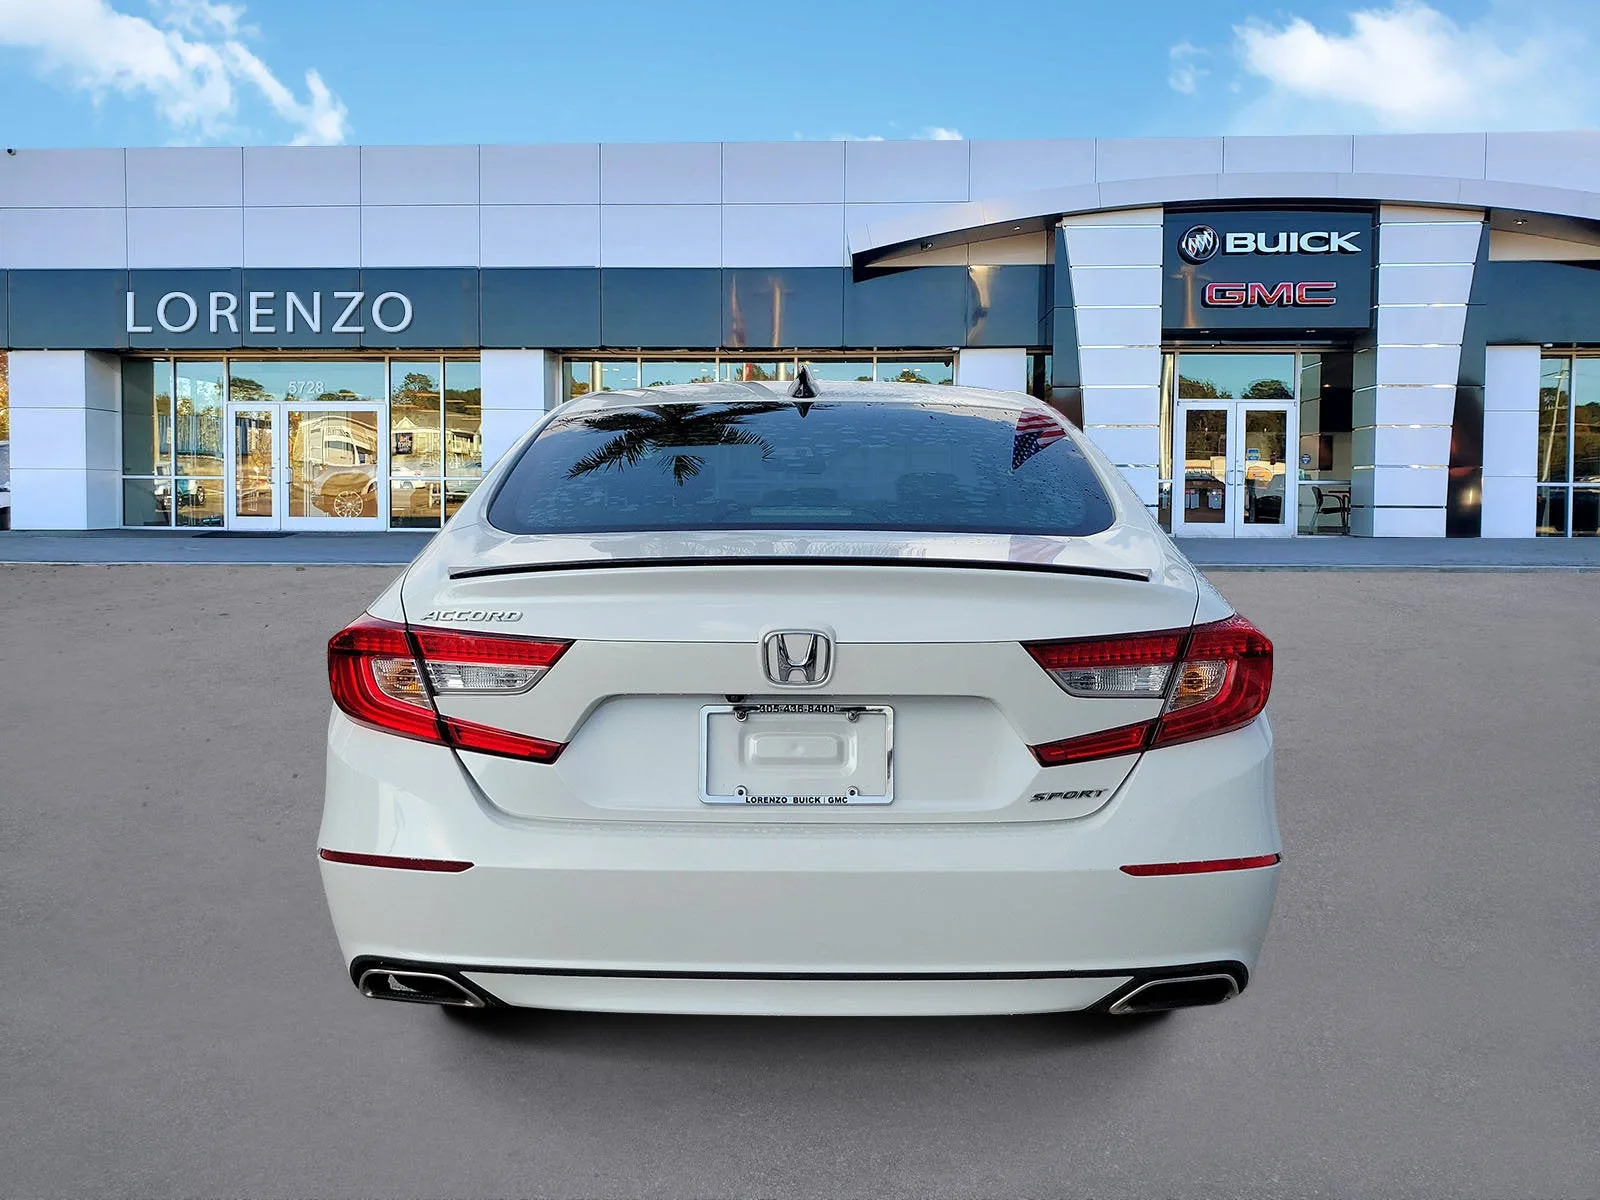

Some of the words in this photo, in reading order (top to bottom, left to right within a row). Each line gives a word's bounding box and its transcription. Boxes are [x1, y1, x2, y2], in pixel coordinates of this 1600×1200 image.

[1225, 231, 1362, 253] BUICK
[1205, 282, 1337, 305] GMC
[126, 291, 413, 333] LORENZO
[289, 380, 325, 394] 5728
[420, 610, 523, 622] ACCORD
[759, 704, 835, 713] 305-436-8400
[745, 796, 788, 804] LORENZO
[792, 796, 821, 804] BUICK
[827, 796, 848, 804] GMC
[1030, 788, 1108, 802] SPORT
